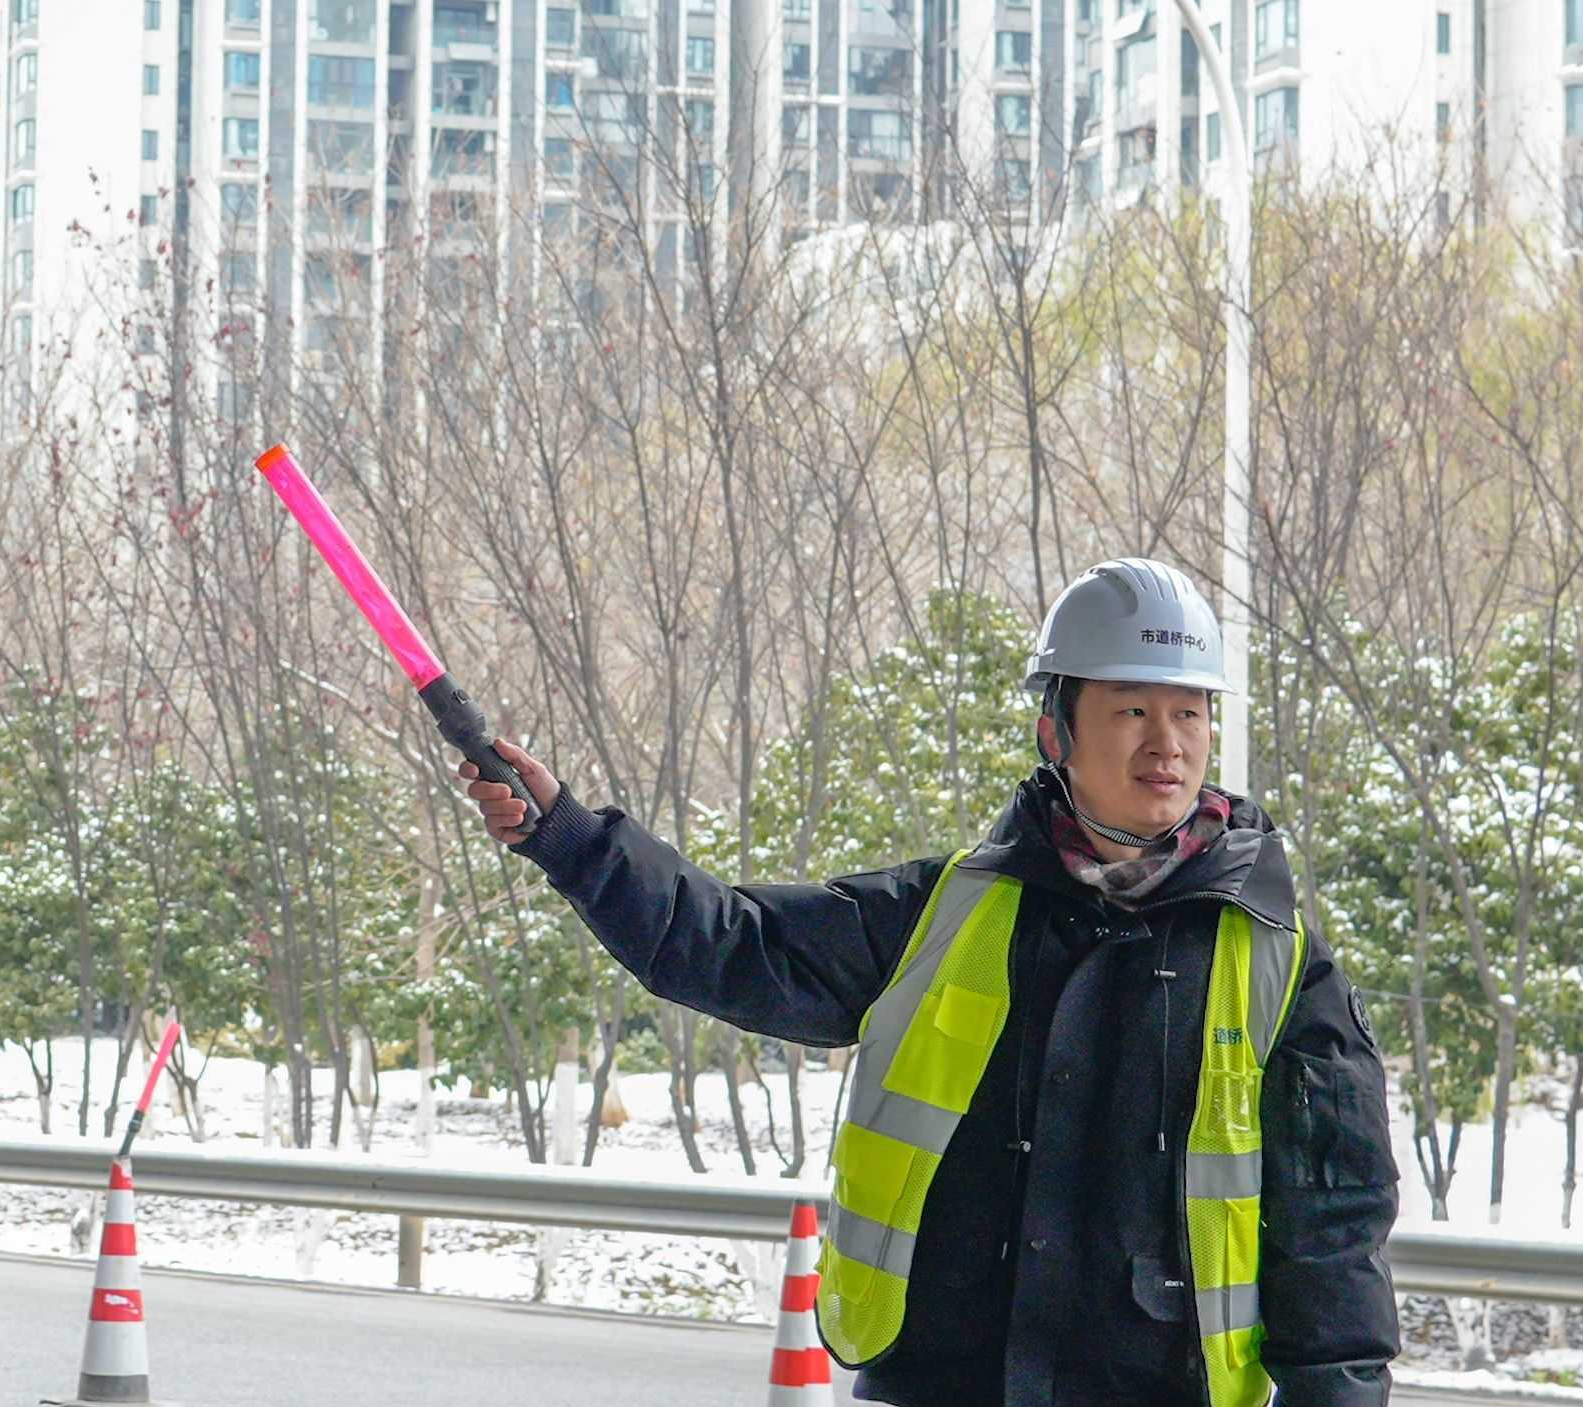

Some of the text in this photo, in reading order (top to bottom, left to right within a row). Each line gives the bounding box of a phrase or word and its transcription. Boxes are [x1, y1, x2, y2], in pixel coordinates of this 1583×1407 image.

[1140, 628, 1207, 652] 市道桥中心
